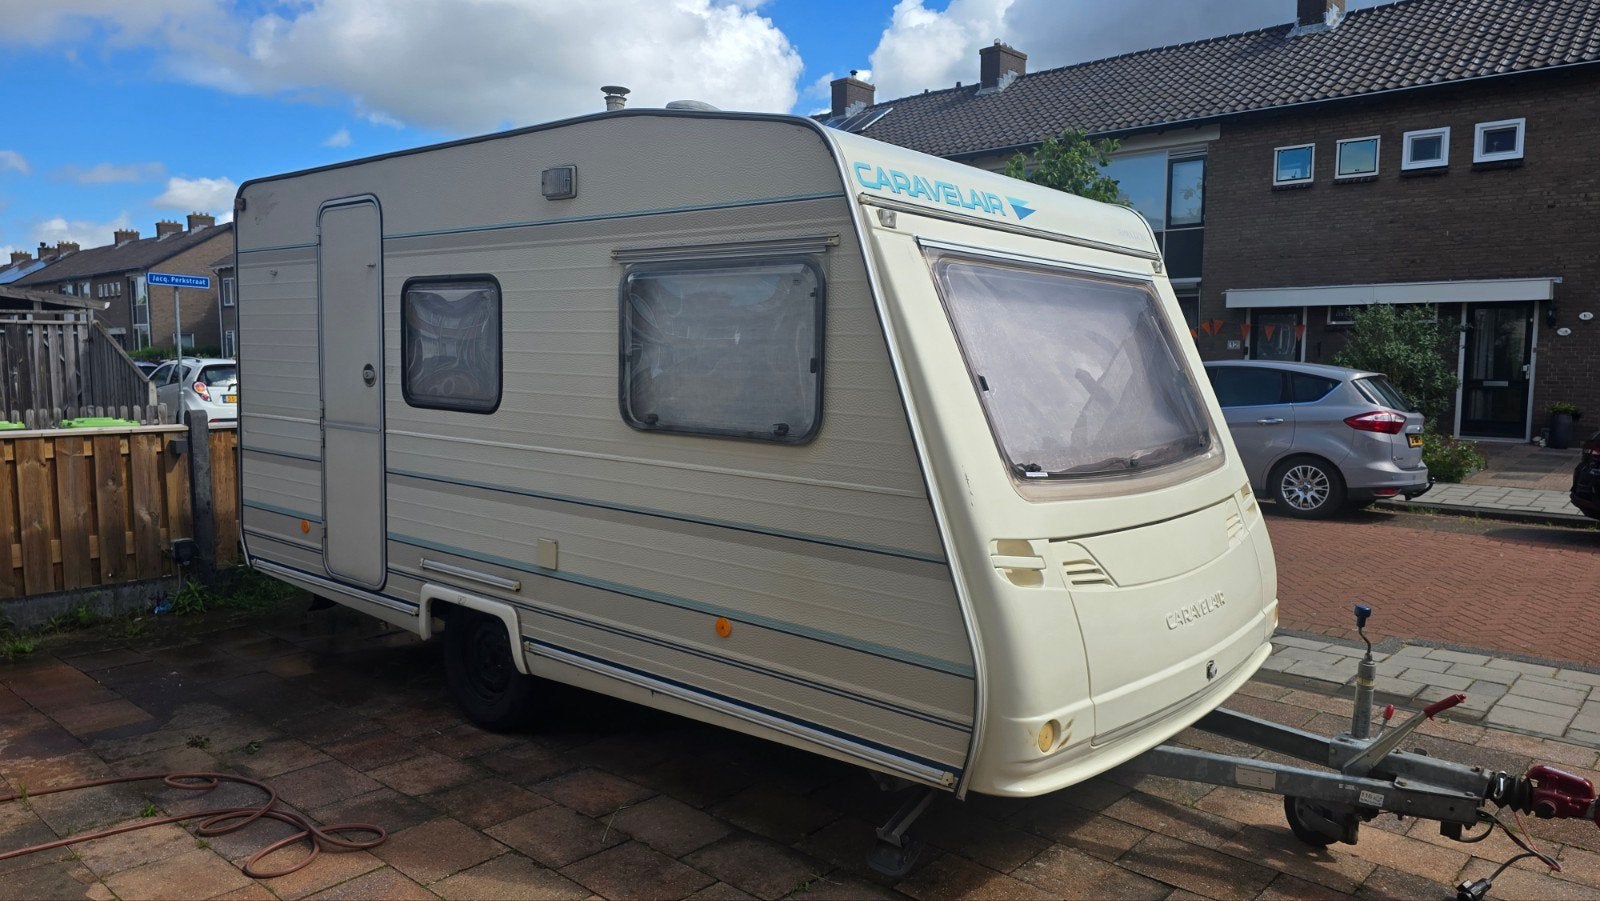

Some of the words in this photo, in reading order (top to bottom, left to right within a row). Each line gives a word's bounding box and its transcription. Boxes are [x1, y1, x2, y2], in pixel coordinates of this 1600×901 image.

[854, 162, 1006, 216] CARAVELAIR
[152, 275, 170, 283] Jacq.
[171, 276, 206, 285] Perkstraat
[1165, 592, 1225, 630] CARAVELAIR
